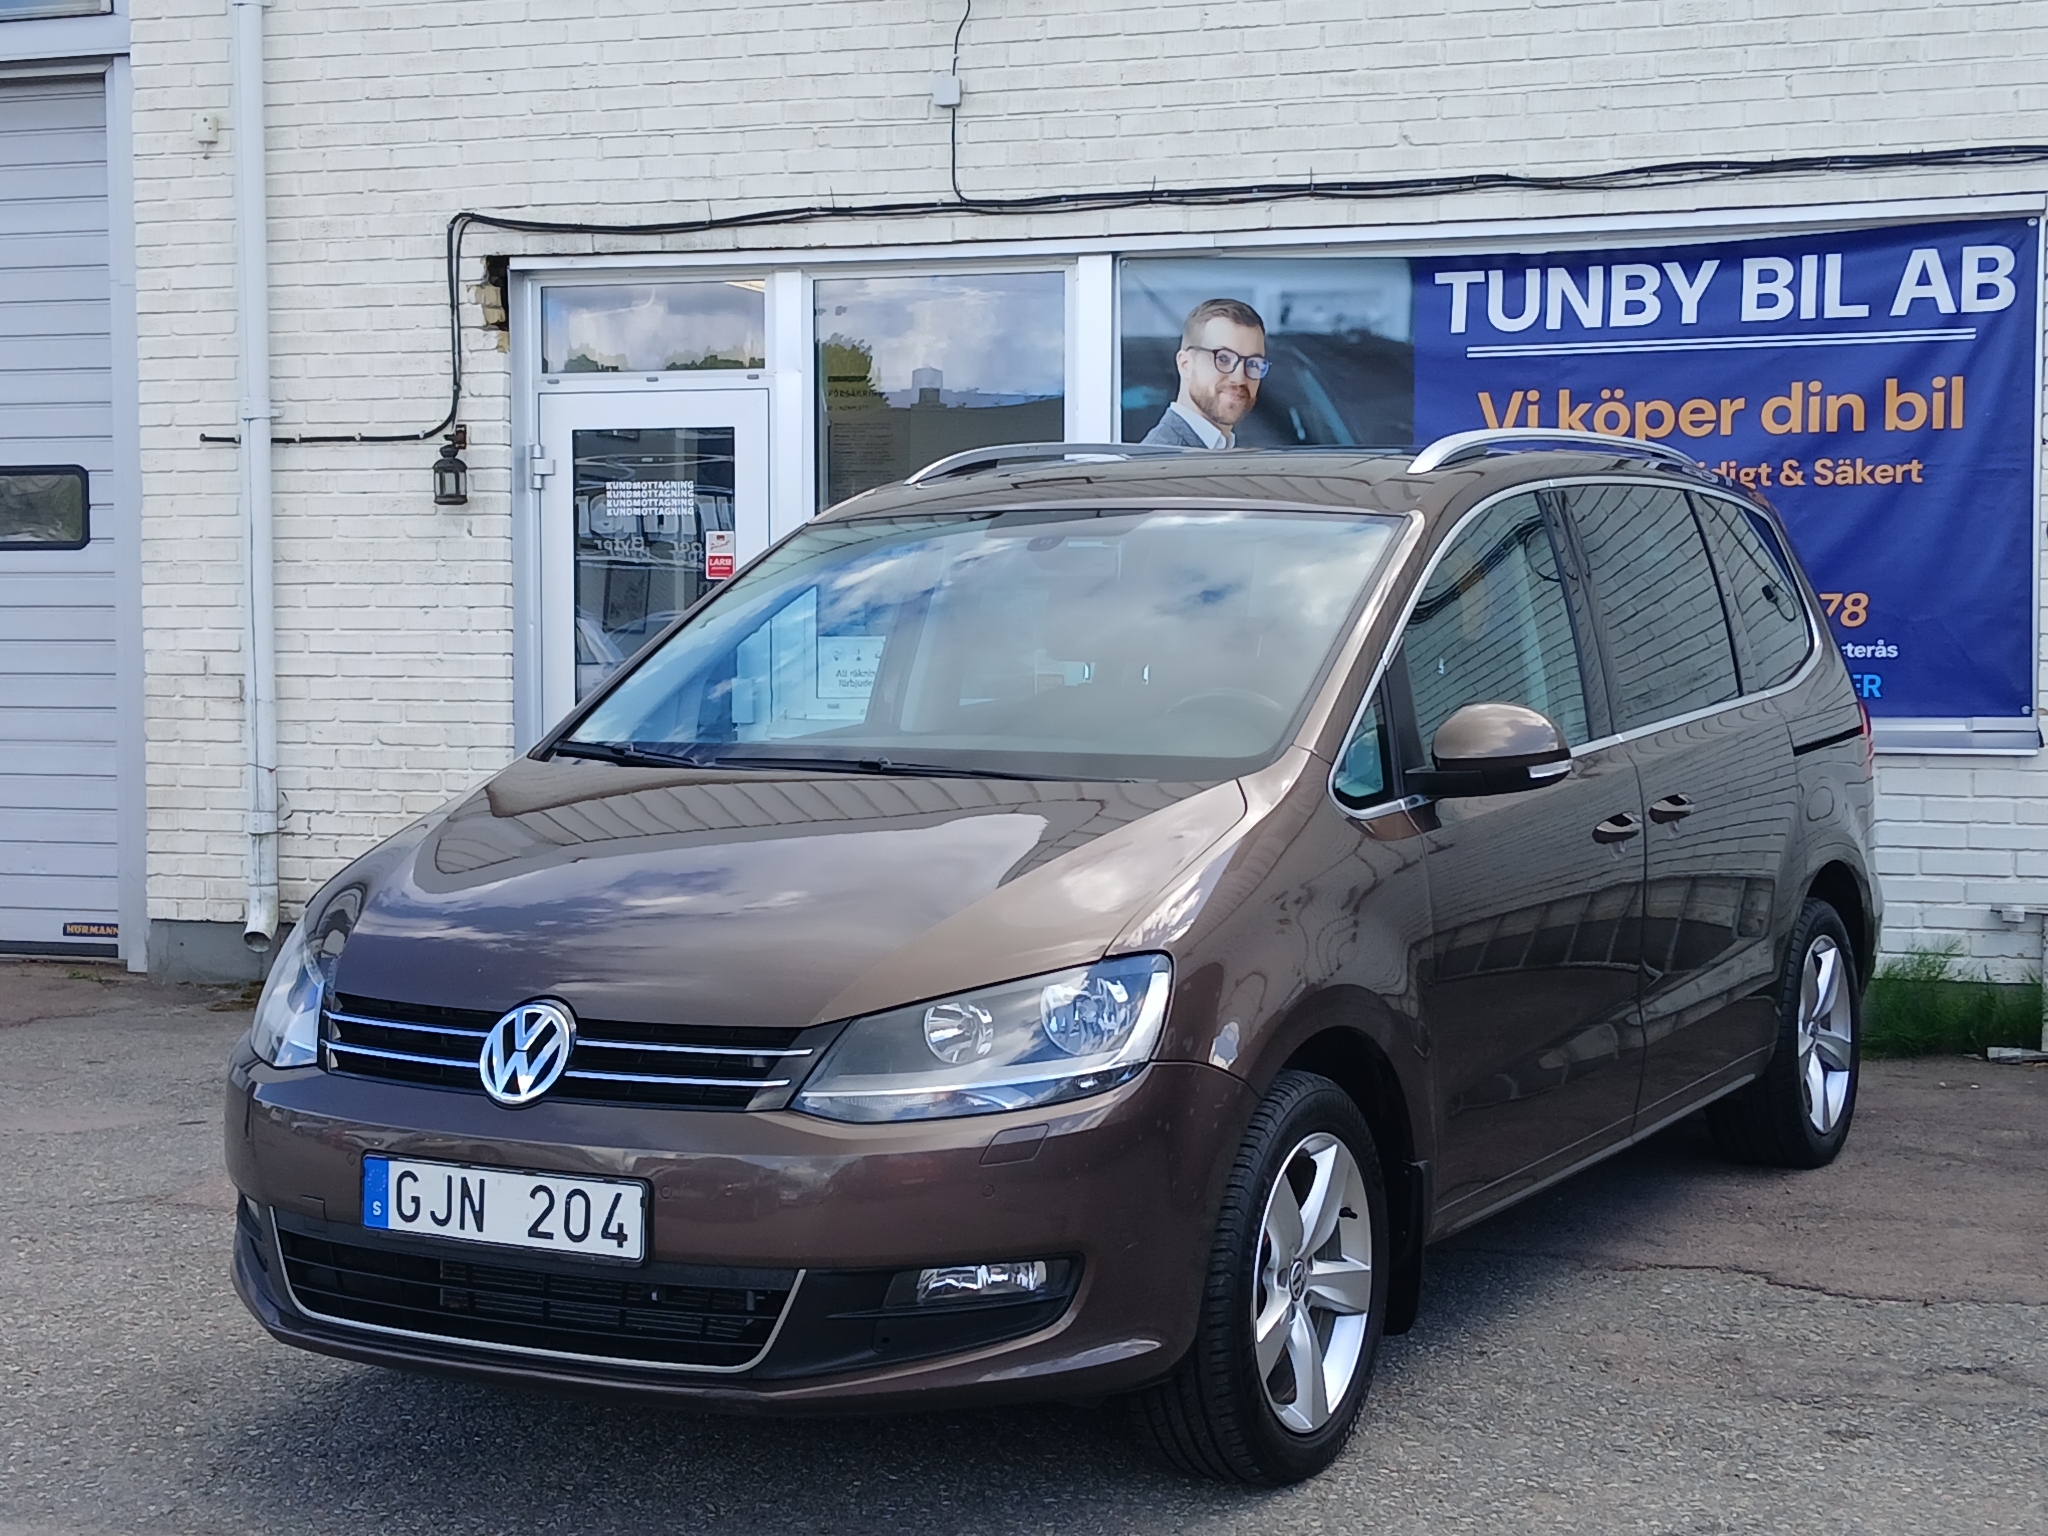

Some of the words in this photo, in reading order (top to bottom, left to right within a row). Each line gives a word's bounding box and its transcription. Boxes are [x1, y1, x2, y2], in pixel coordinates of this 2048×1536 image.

[1434, 259, 1720, 334] TUNBY
[1740, 252, 1869, 322] BIL
[1889, 244, 2017, 317] AB
[1478, 390, 1540, 429] Vi
[1558, 389, 1746, 440] köper
[1760, 382, 1866, 435] din
[1884, 376, 1965, 431] bil
[1779, 459, 1805, 487] &
[1813, 457, 1923, 486] Säkert
[606, 481, 694, 490] KUNDMOTTAGNING
[606, 490, 694, 498] KUNDMOTTAGNING
[606, 499, 694, 507] KUNDMOTTAGNING
[606, 508, 694, 516] KUNDMOTTAGNING
[372, 1201, 382, 1216] S
[396, 1170, 485, 1232] GJN
[527, 1184, 628, 1248] 204
